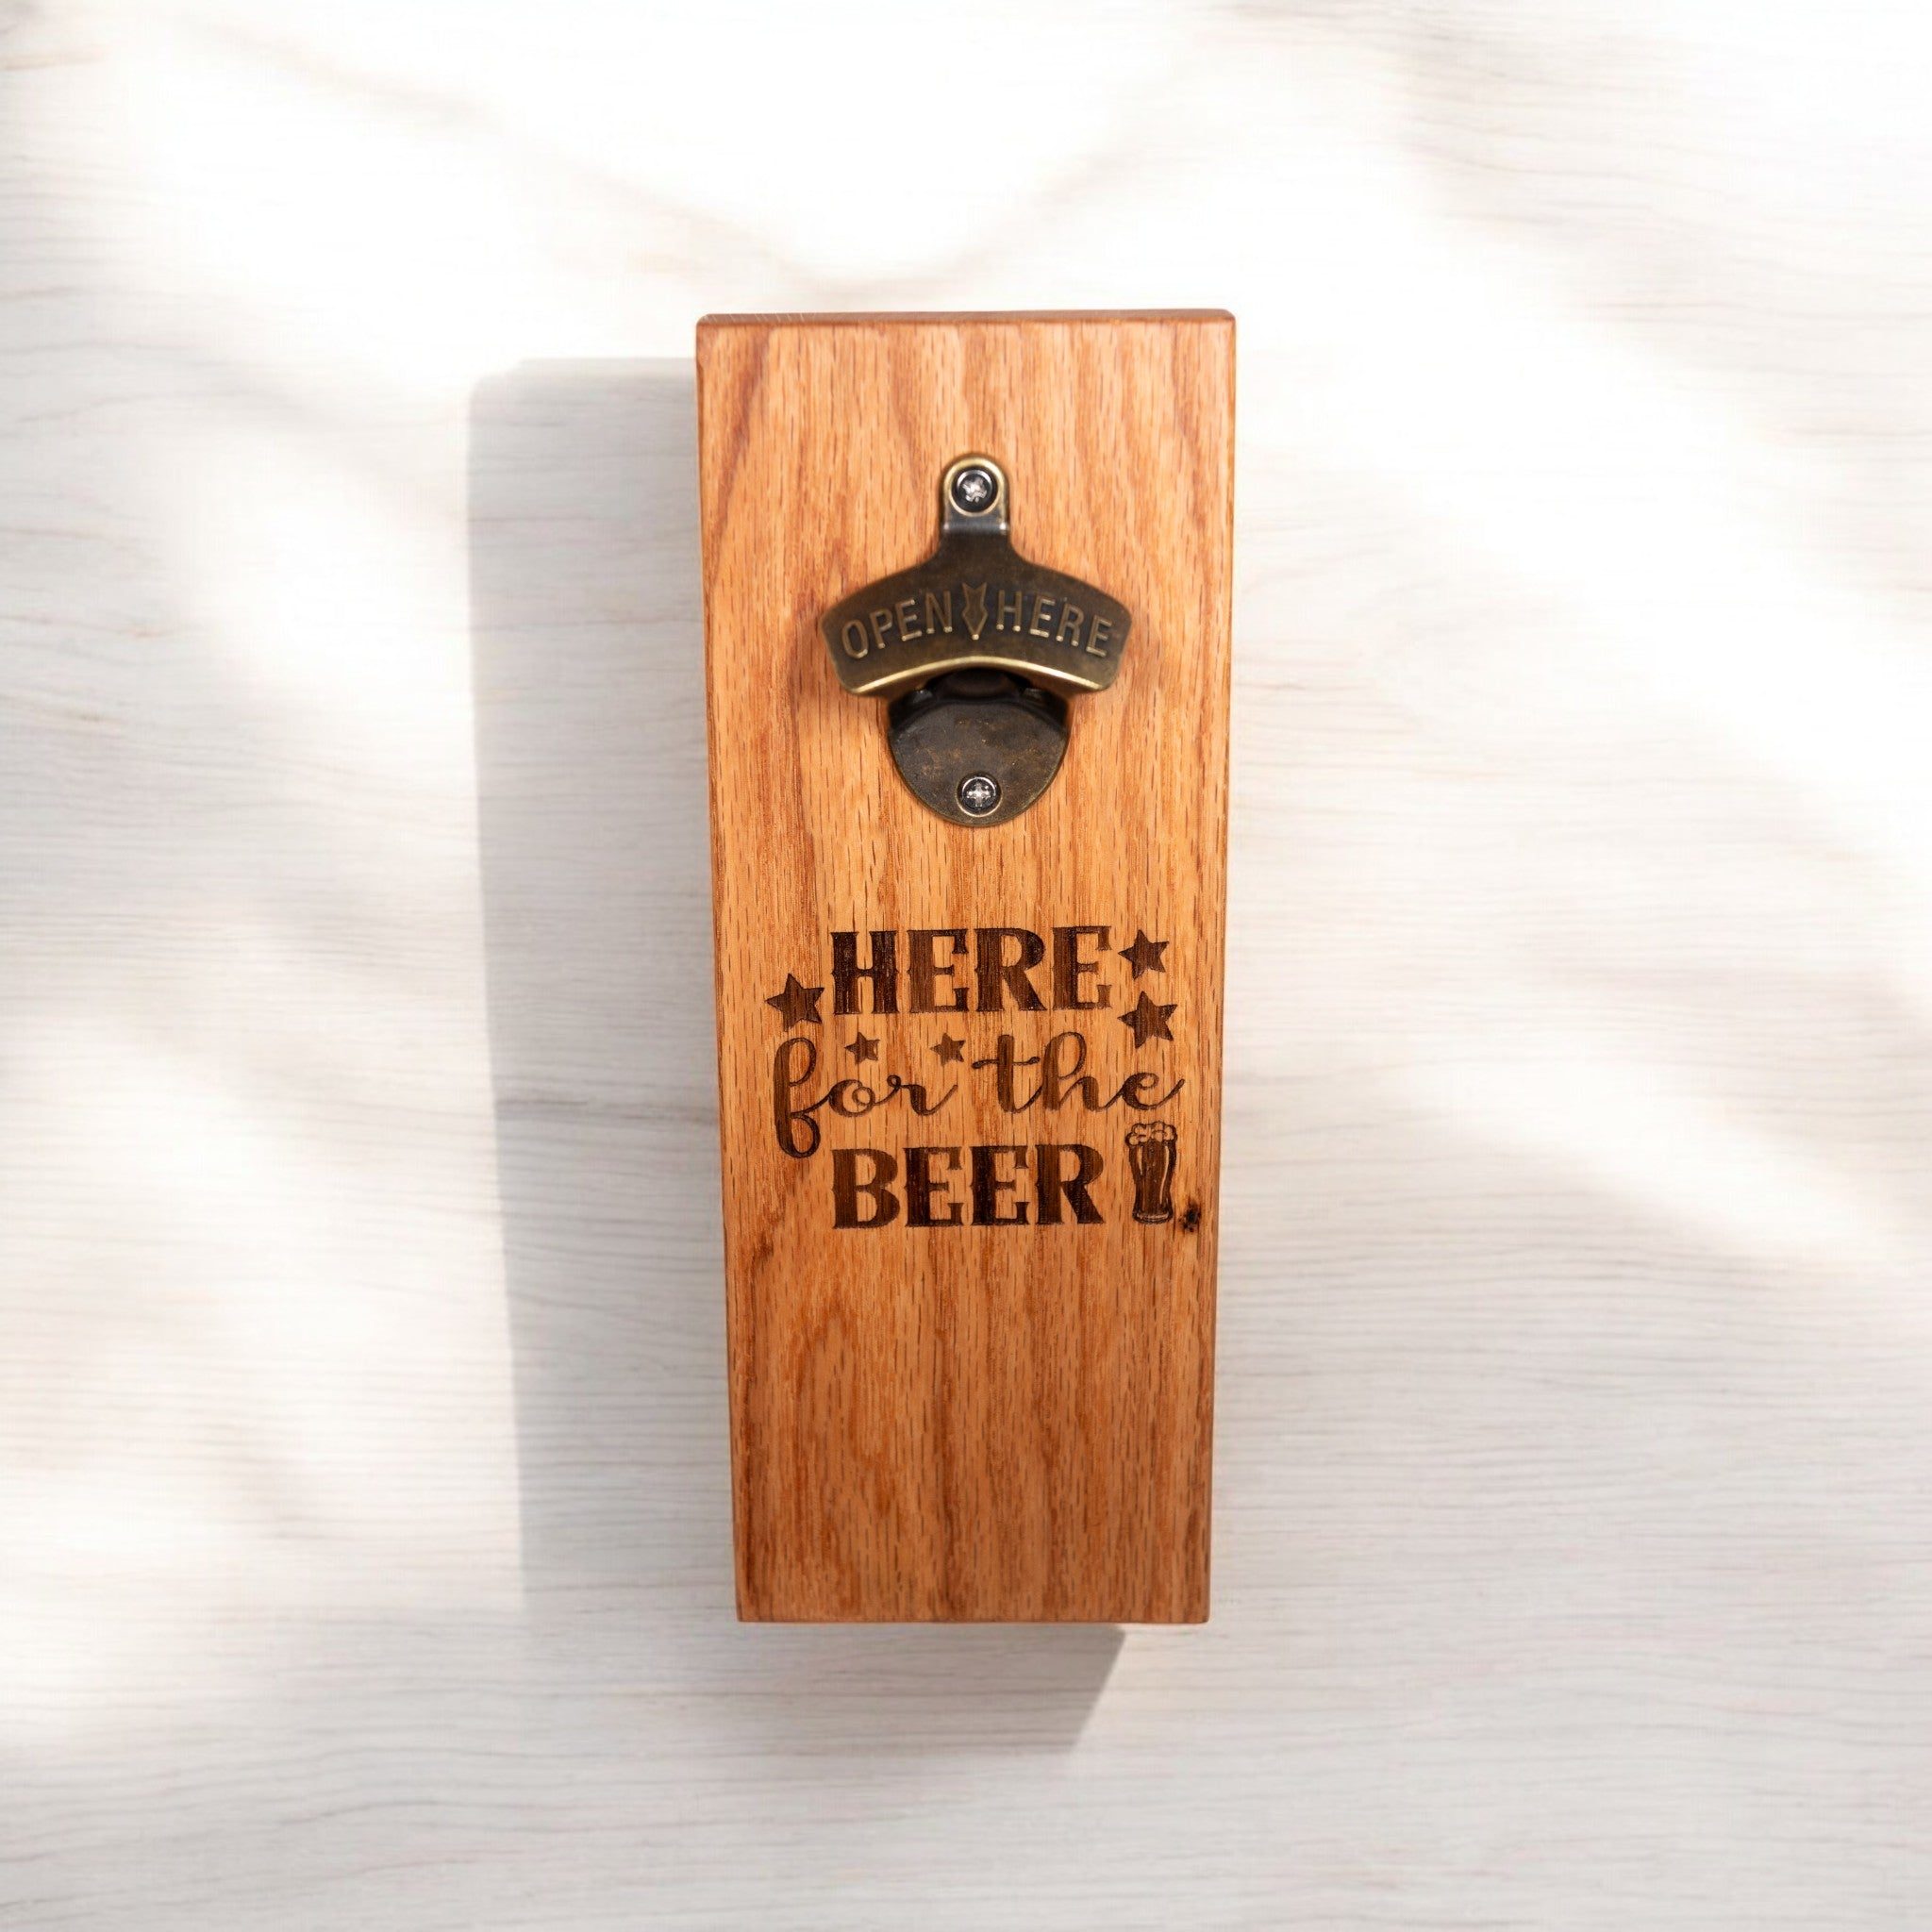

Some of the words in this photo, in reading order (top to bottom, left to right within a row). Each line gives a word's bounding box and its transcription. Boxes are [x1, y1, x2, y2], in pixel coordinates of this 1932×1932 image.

[841, 590, 953, 659] OPEN
[995, 590, 1113, 658] HERE
[830, 925, 1113, 1015] HERE
[773, 1037, 958, 1159] for
[972, 1031, 1186, 1114] the
[830, 1143, 1105, 1229] BEER
